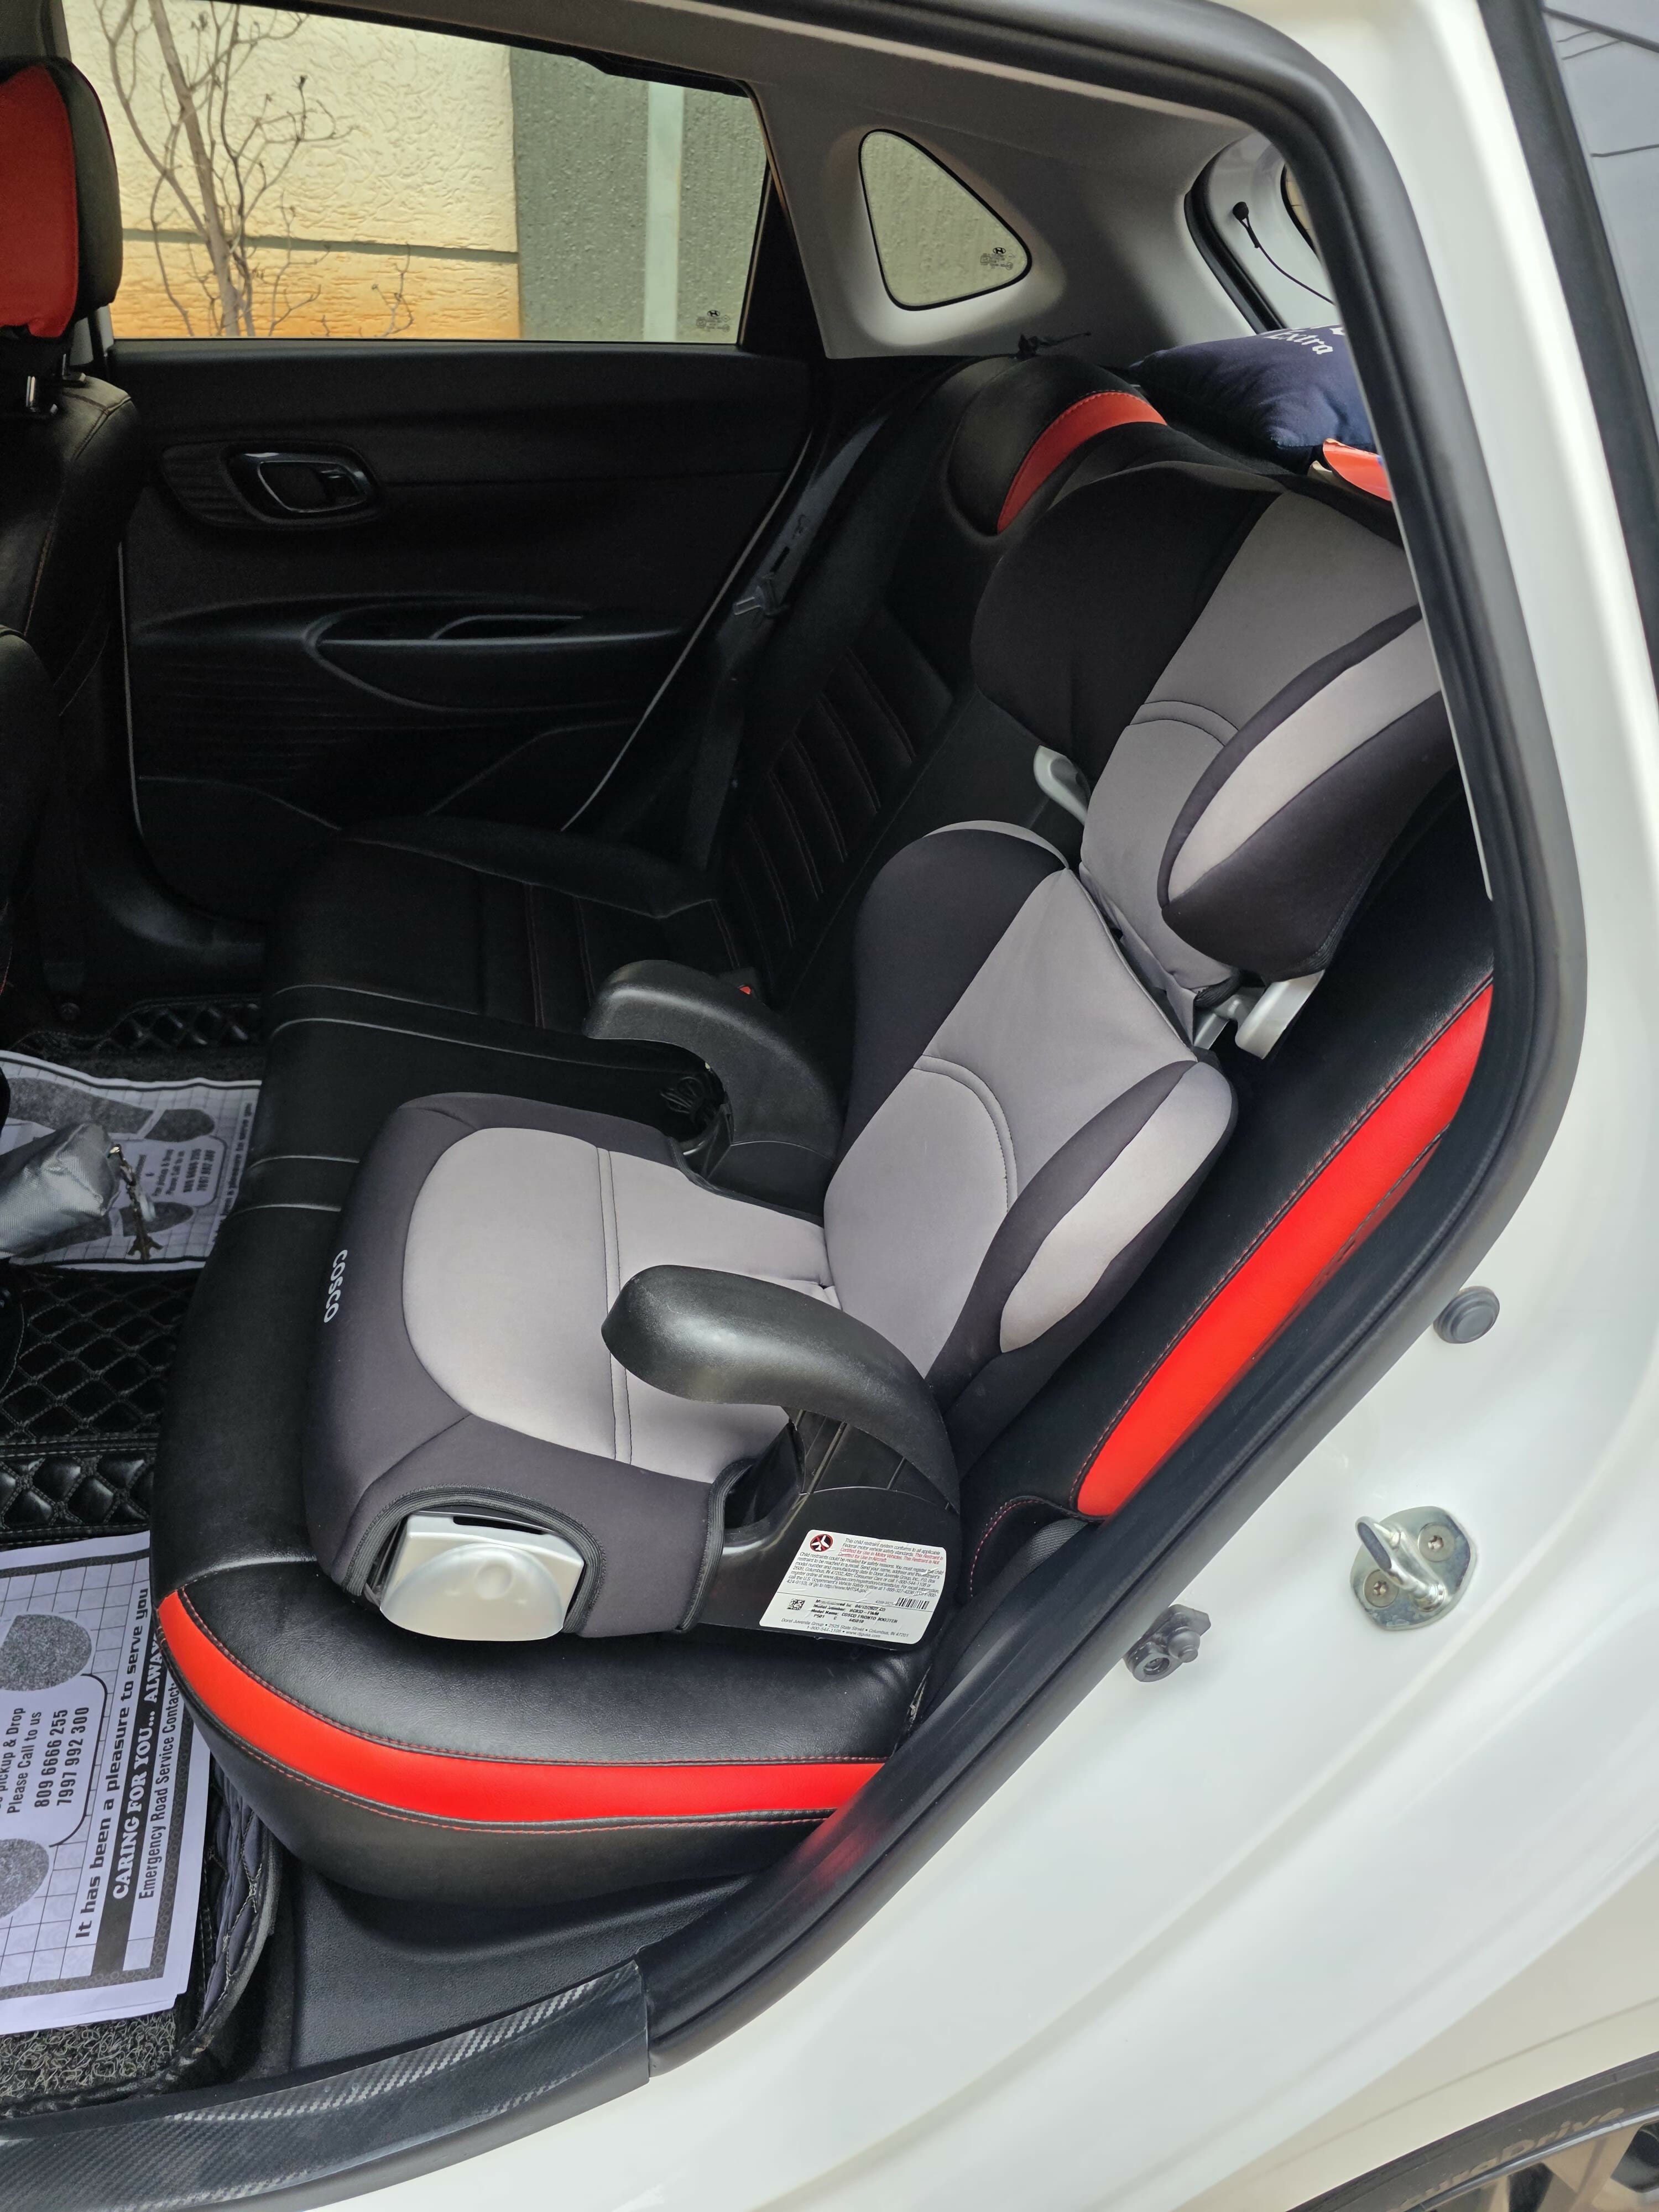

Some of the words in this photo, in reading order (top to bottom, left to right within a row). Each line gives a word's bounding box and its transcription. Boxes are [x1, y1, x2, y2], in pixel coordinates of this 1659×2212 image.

[1264, 330, 1334, 355] Extra
[324, 1249, 348, 1323] COSCO
[135, 1588, 149, 1621] you
[127, 1625, 143, 1675] serve
[120, 1681, 134, 1702] to
[6, 1708, 26, 1735] Drop
[24, 1729, 38, 1741] to
[30, 1712, 42, 1725] us
[49, 1709, 69, 1736] 255
[71, 1707, 90, 1734] 300
[3, 1739, 17, 1748] &
[18, 1745, 35, 1768] Call
[65, 1738, 84, 1766] 992
[105, 1707, 130, 1792] pleasure
[134, 1710, 156, 1771] YOU...
[41, 1739, 62, 1776] 6666
[155, 1735, 175, 1786] Service
[7, 1772, 29, 1814] Please
[34, 1780, 54, 1808] 809
[56, 1772, 77, 1806] 7997
[103, 1798, 115, 1811] a
[127, 1771, 148, 1814] FOR
[150, 1788, 169, 1823] Road
[89, 1817, 112, 1869] been
[112, 1816, 140, 1900] CARING
[138, 1824, 167, 1899] Emergency
[80, 1875, 101, 1914] has
[75, 1920, 92, 1939] It
